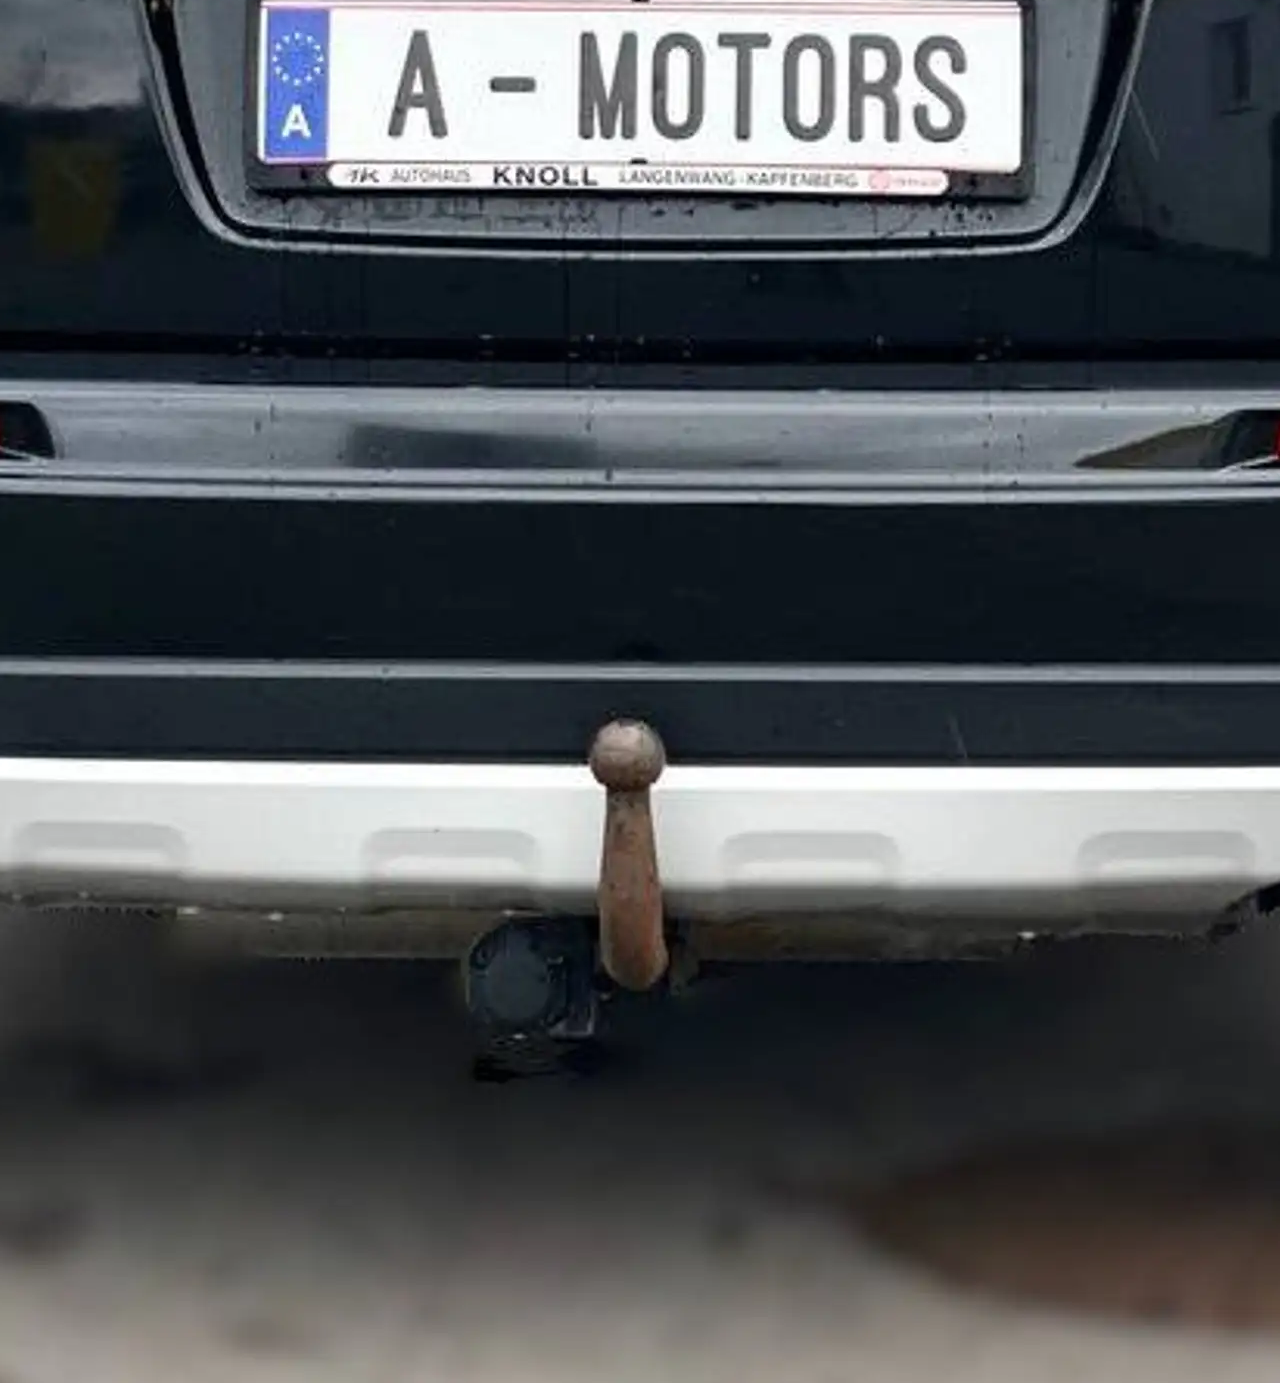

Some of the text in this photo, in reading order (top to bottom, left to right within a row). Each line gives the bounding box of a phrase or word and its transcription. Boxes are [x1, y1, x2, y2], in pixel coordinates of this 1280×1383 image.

[388, 29, 449, 139] A
[578, 32, 967, 143] MOTORS
[281, 105, 311, 137] A
[389, 169, 471, 183] AUTOHAUS
[492, 166, 599, 186] KNOLL
